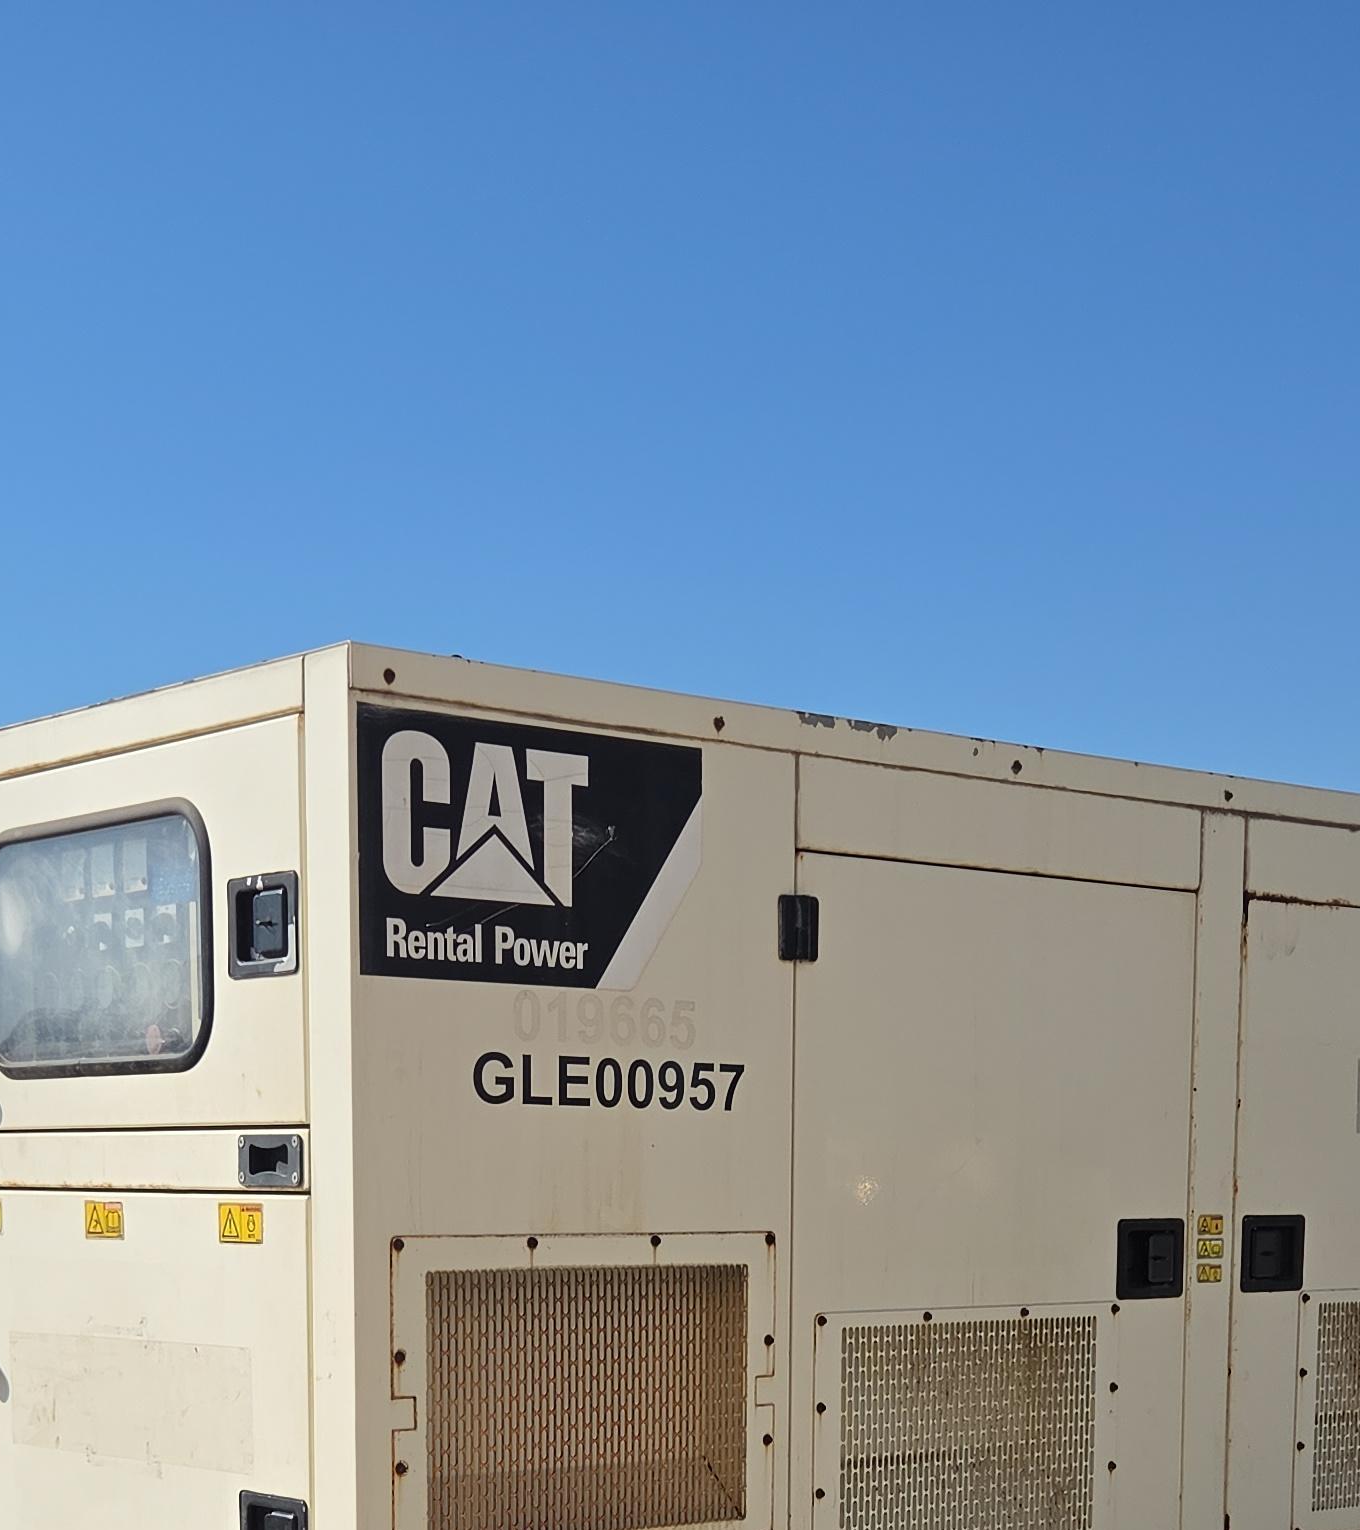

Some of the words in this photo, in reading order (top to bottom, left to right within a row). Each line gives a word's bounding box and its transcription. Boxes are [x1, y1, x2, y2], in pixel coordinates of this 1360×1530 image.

[381, 730, 589, 908] CAT
[386, 917, 483, 964] Rental
[495, 925, 589, 970] Power
[513, 989, 696, 1050] 019665
[472, 1051, 745, 1112] GLE00957
